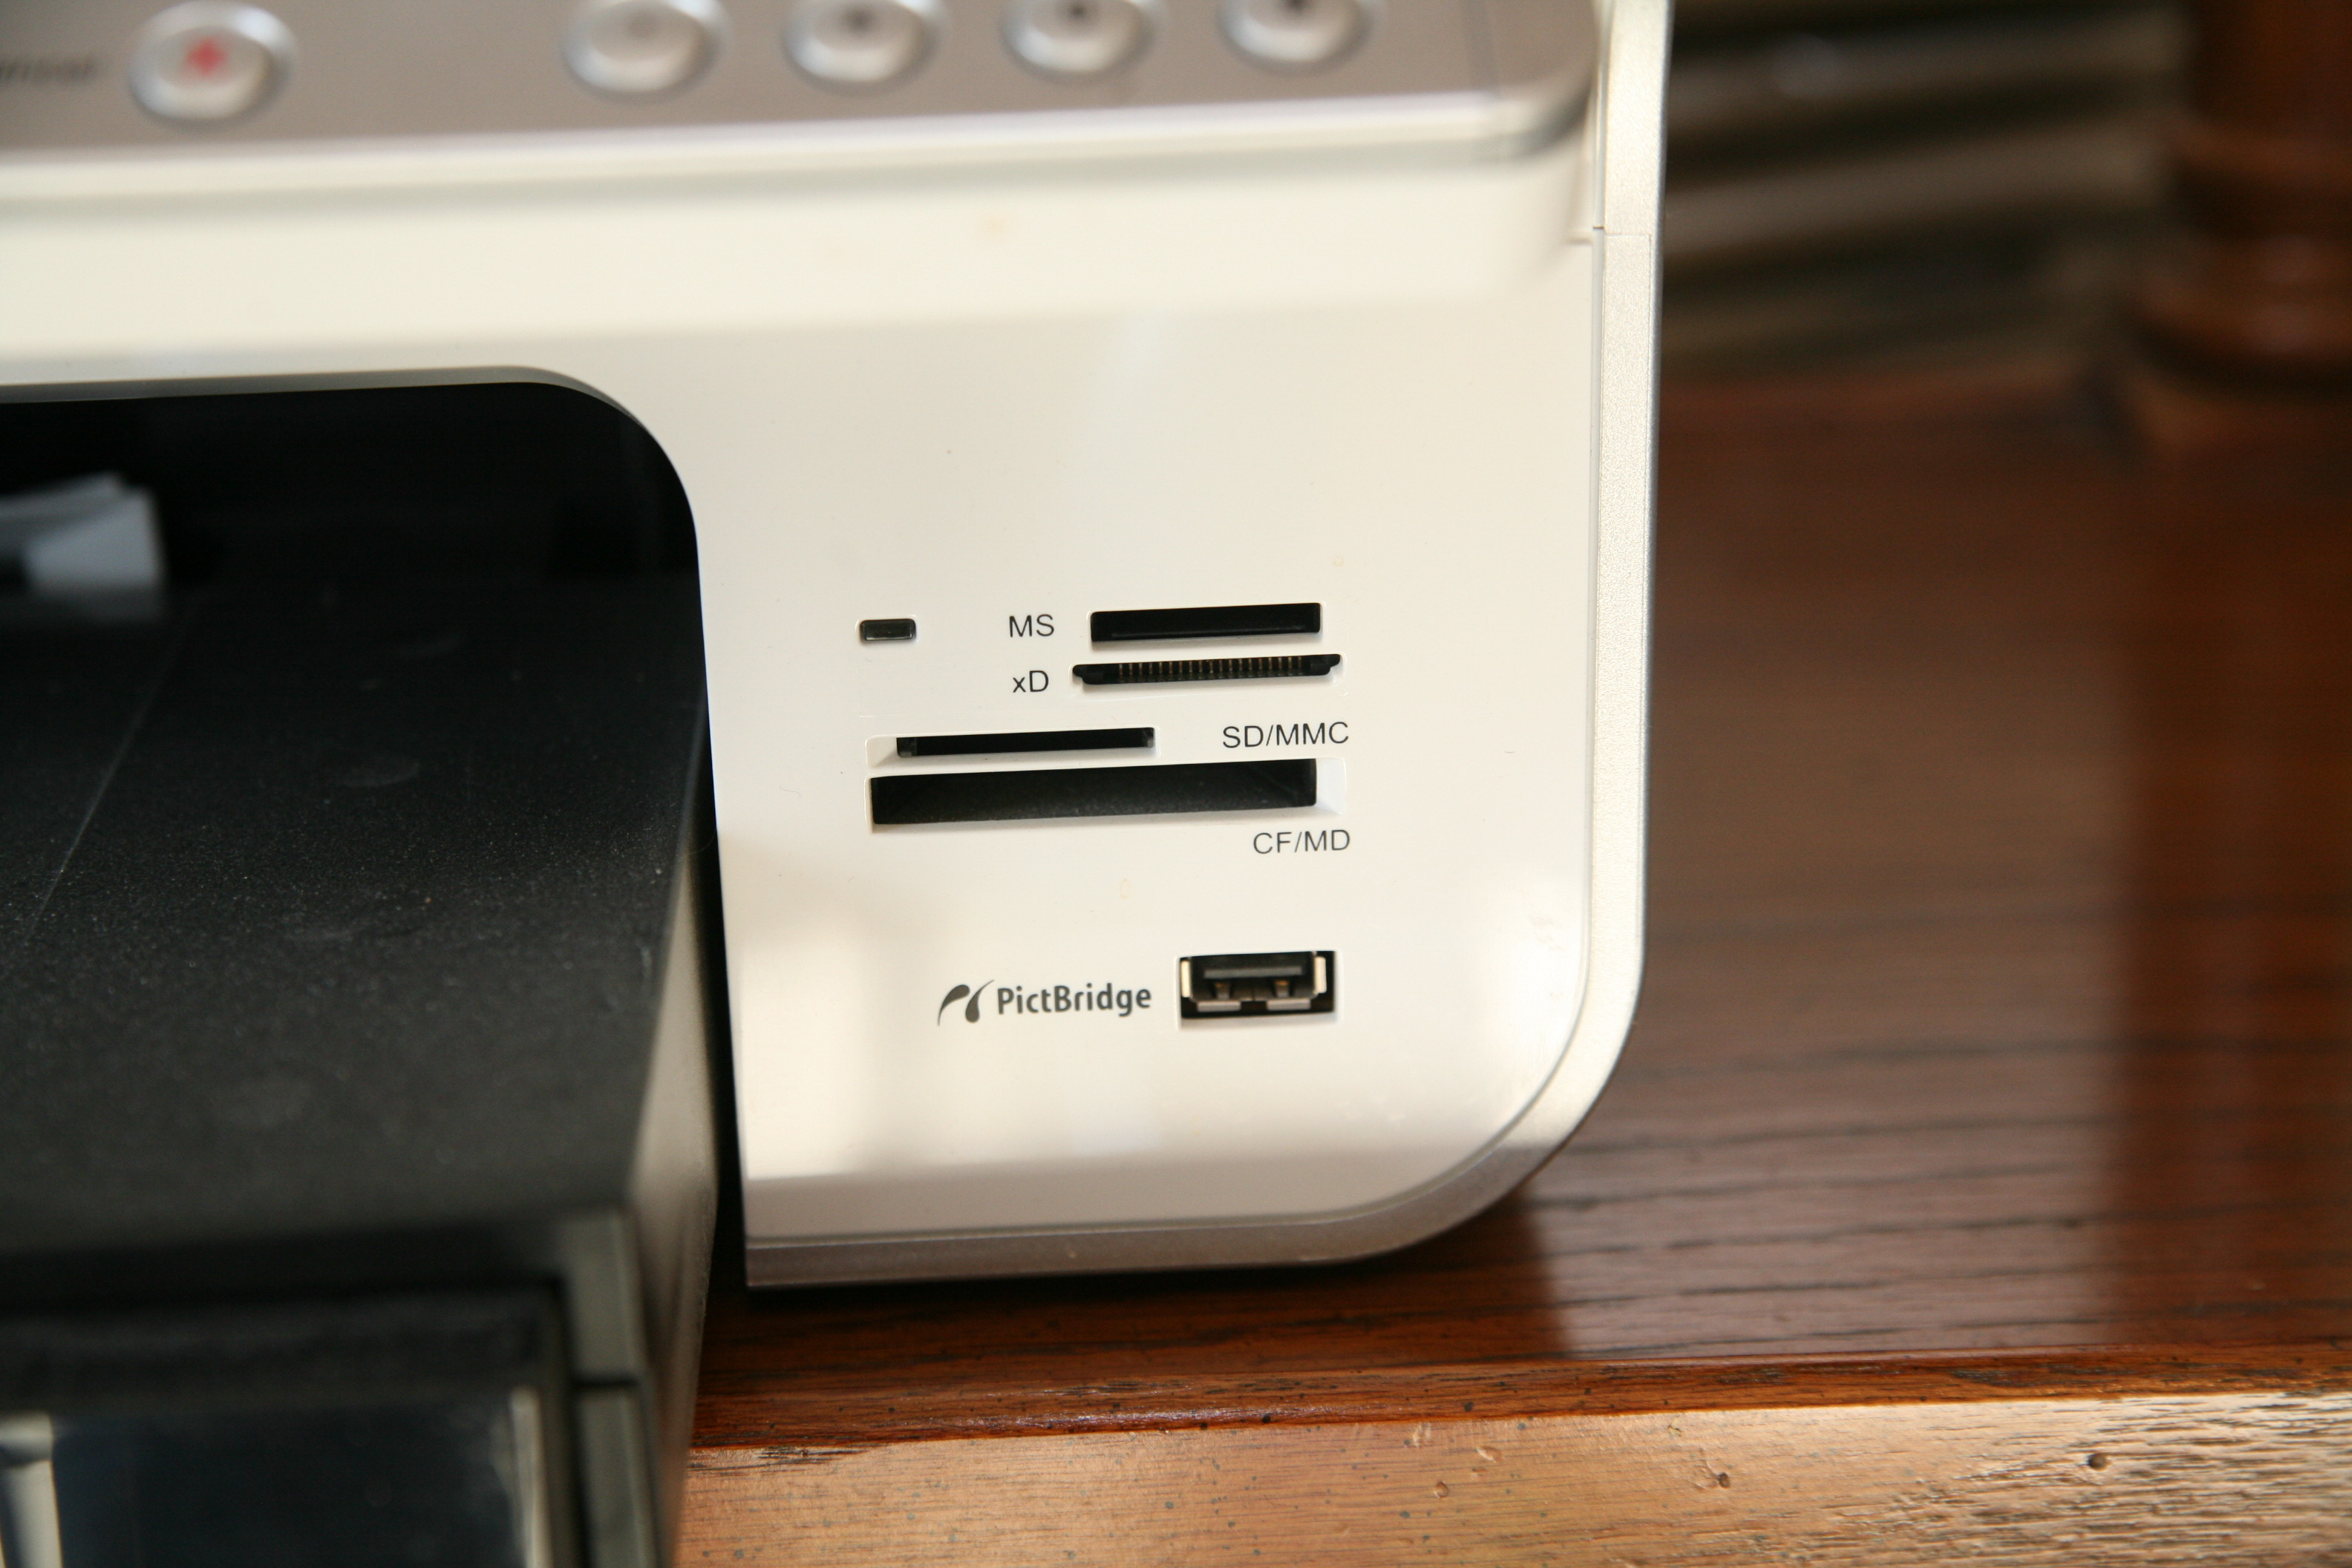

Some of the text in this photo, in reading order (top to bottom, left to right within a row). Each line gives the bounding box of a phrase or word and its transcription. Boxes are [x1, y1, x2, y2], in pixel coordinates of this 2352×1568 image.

[1009, 613, 1055, 638] MS
[1012, 670, 1049, 693] xD
[1222, 721, 1350, 749] SD/MMC
[1252, 829, 1350, 855] CF/MD
[996, 981, 1152, 1017] PictBridge
